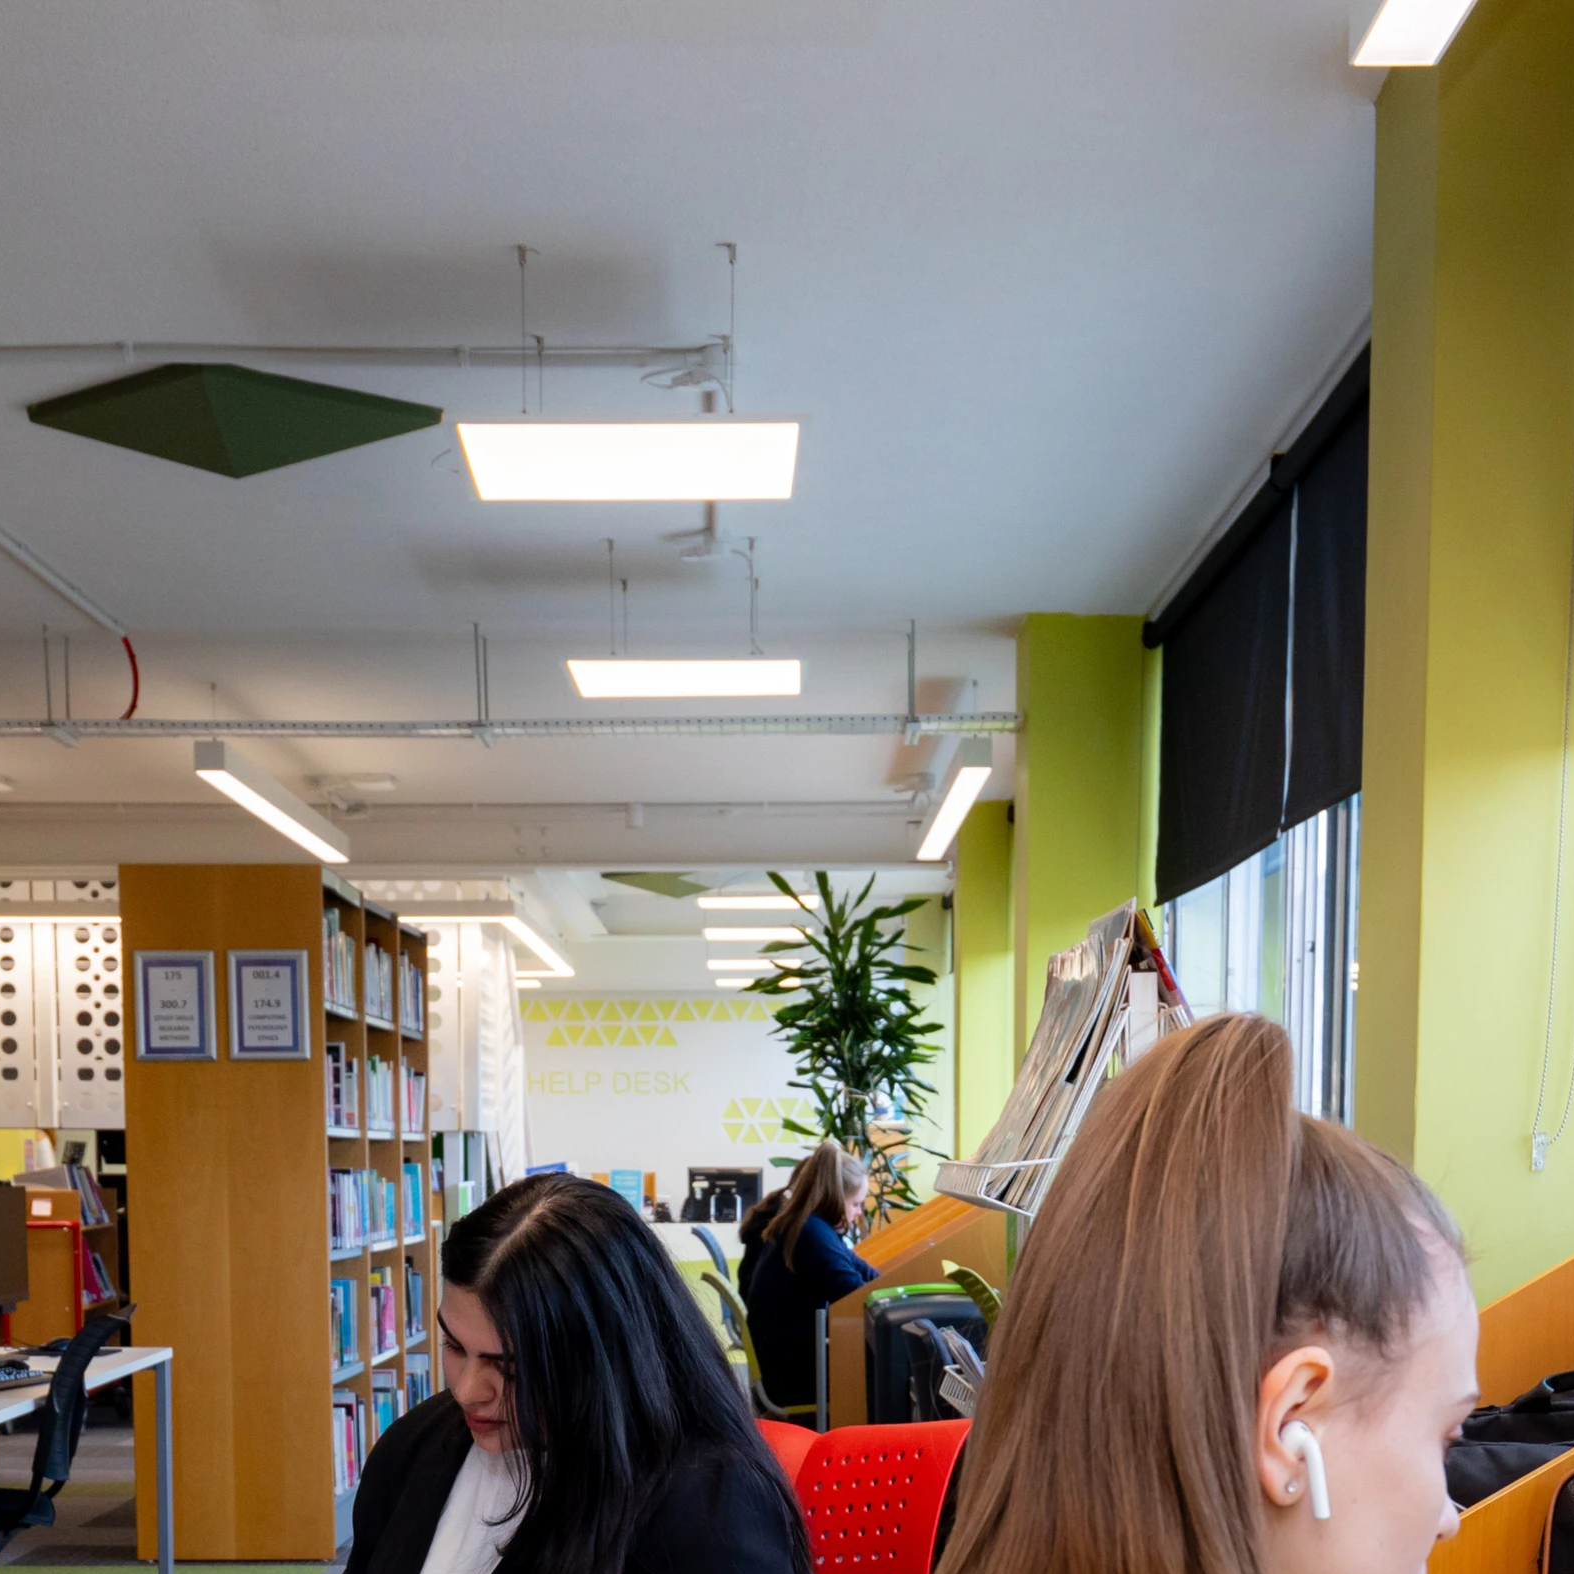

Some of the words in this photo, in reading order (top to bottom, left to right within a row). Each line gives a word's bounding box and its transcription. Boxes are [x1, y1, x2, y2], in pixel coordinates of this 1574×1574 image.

[163, 971, 182, 980] 175
[252, 970, 280, 980] 001.4
[159, 1000, 187, 1009] 300.7
[254, 999, 281, 1009] 174.9
[527, 1071, 602, 1095] HELP
[612, 1070, 692, 1095] DESK
